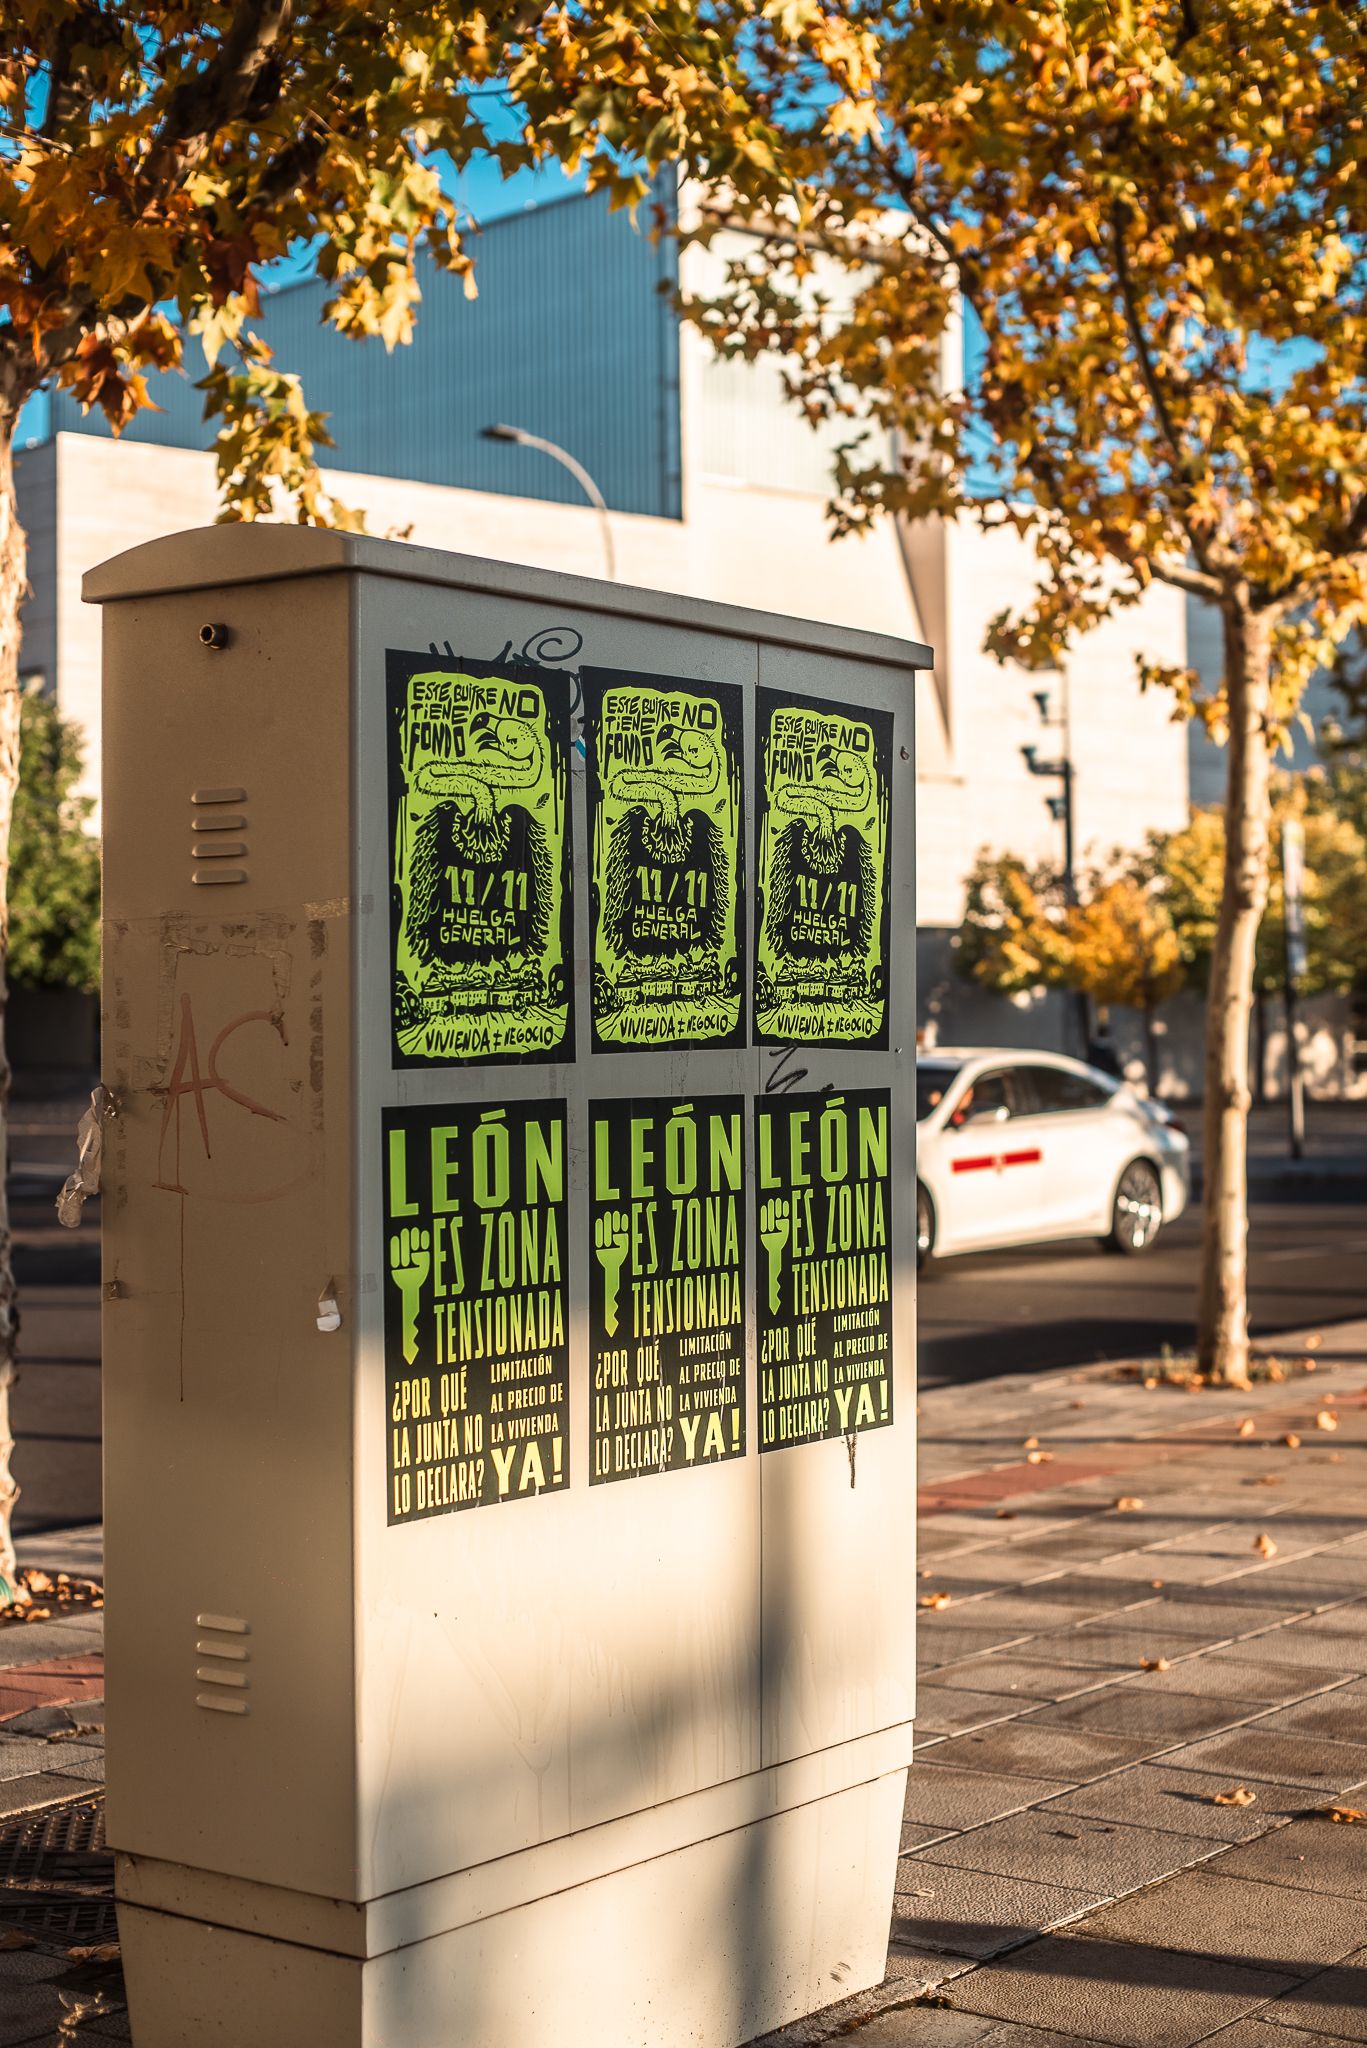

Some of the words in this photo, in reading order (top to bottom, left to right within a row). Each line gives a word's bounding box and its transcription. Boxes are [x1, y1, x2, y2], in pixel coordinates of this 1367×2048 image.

[413, 682, 452, 701] ESTE
[500, 689, 539, 718] NO
[607, 696, 640, 714] ESTE
[682, 702, 717, 730] NO
[408, 722, 466, 771] FONDO
[775, 715, 804, 733] ESTE
[839, 725, 870, 752] NO
[604, 733, 653, 780] FONDO
[770, 750, 813, 792] FONDO
[440, 925, 520, 946] GENERAL
[443, 908, 516, 926] HUELGA
[632, 921, 700, 940] GENERAL
[635, 905, 697, 922] HUELGA
[791, 925, 850, 946] GENERAL
[794, 910, 847, 930] HUELGA
[426, 1028, 490, 1053] VIVIENDA
[504, 1026, 553, 1046] NEGOCIO
[620, 1016, 675, 1039] VIVIENDA
[686, 1014, 728, 1032] NEGOCIO
[778, 1013, 825, 1037] VIVIENDA
[835, 1017, 873, 1035] NEGOCIO
[389, 1108, 562, 1218] LEÓN
[595, 1103, 741, 1201] LEÓN
[759, 1096, 887, 1189] LEÓN
[632, 1201, 658, 1276] ES
[672, 1195, 739, 1271] ZONA
[792, 1188, 814, 1258] ES
[826, 1182, 886, 1253] ZONA
[433, 1216, 465, 1297] ES
[480, 1207, 561, 1291] ZONA
[632, 1271, 741, 1338] TENSIONADA
[792, 1252, 888, 1316] TENSIONADA
[434, 1289, 564, 1364] TENSIONADA
[762, 1327, 789, 1364] ¿POR
[797, 1317, 816, 1361] QUÉ
[834, 1308, 879, 1332] LIMITACIÓN
[595, 1349, 628, 1390] ¿POR
[637, 1339, 659, 1387] QUÉ
[680, 1331, 731, 1356] LIMITACIÓN
[834, 1341, 843, 1358] AL
[847, 1335, 874, 1356] PRECIO
[878, 1333, 888, 1351] DE
[491, 1354, 552, 1383] LIMITACIÓN
[679, 1366, 690, 1384] AL
[694, 1361, 726, 1382] PRECIO
[730, 1358, 740, 1376] DE
[763, 1369, 774, 1404] LA
[779, 1362, 810, 1400] JUNTA
[815, 1359, 828, 1393] NO
[834, 1367, 844, 1384] LA
[847, 1359, 884, 1382] VIVIENDA
[393, 1377, 431, 1422] ¿POR
[440, 1365, 467, 1417] QUÉ
[491, 1392, 504, 1414] AL
[508, 1385, 546, 1410] PRECIO
[550, 1383, 563, 1403] DE
[596, 1395, 610, 1432] LA
[615, 1388, 651, 1429] JUNTA
[657, 1385, 672, 1422] NO
[680, 1393, 690, 1412] LA
[694, 1386, 736, 1409] VIVIENDA
[834, 1380, 888, 1429] YA!
[393, 1427, 410, 1469] LA
[416, 1418, 459, 1464] JUNTA
[464, 1414, 483, 1455] NO
[491, 1422, 504, 1443] LA
[508, 1413, 558, 1440] VIVIENDA
[679, 1408, 740, 1460] YA!
[763, 1409, 775, 1444] LO
[780, 1398, 829, 1440] DECLARA?
[491, 1437, 562, 1495] YA!
[596, 1438, 609, 1476] LO
[616, 1426, 673, 1472] DECLARA?
[394, 1473, 410, 1516] LO
[417, 1458, 485, 1510] DECLARA?
